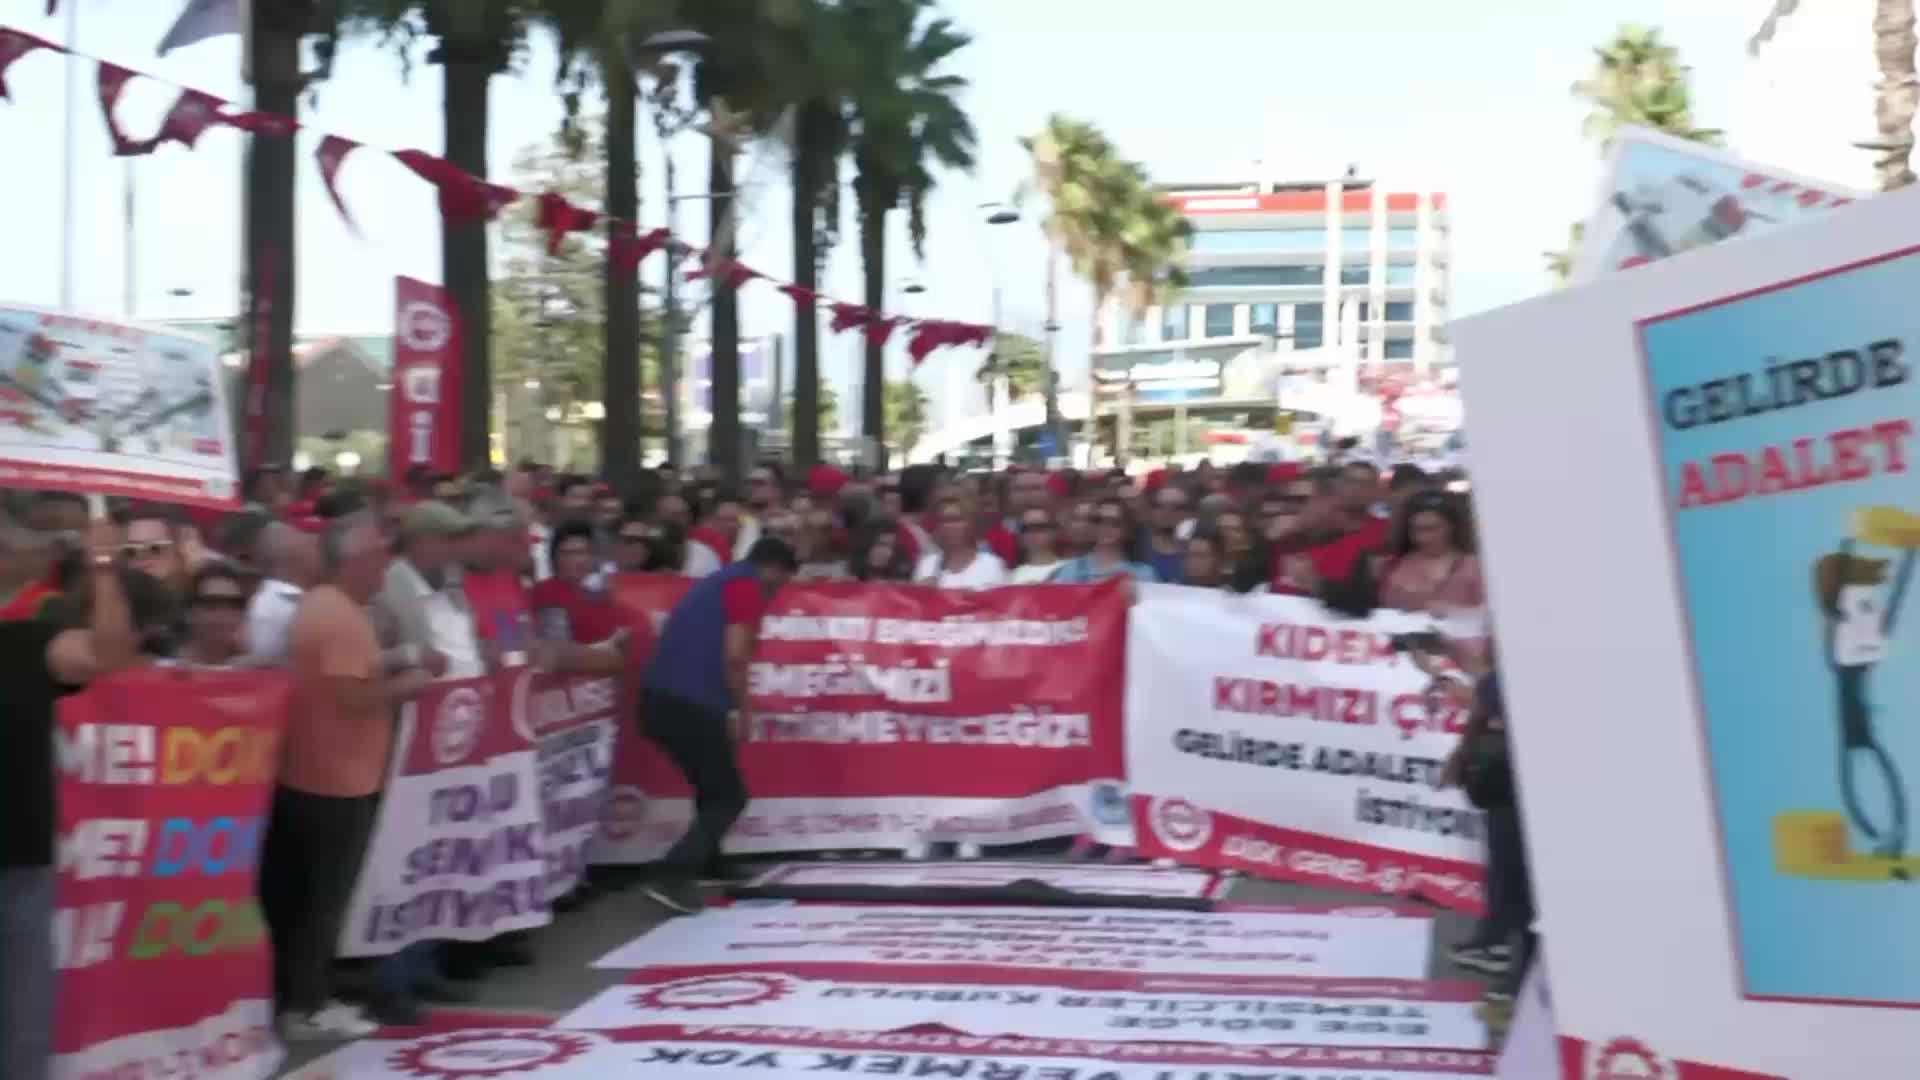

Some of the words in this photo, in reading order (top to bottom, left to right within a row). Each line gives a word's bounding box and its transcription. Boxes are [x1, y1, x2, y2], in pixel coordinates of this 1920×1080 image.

[1663, 338, 1908, 430] GELİRDE
[1679, 420, 1912, 509] ADALET
[1213, 676, 1378, 725] KIRMIZI
[1390, 691, 1468, 739] ÇİZ
[1174, 728, 1303, 771] GELİRDE
[1057, 995, 1428, 1019] TEMSİLCİLER
[638, 1047, 779, 1070] YOK
